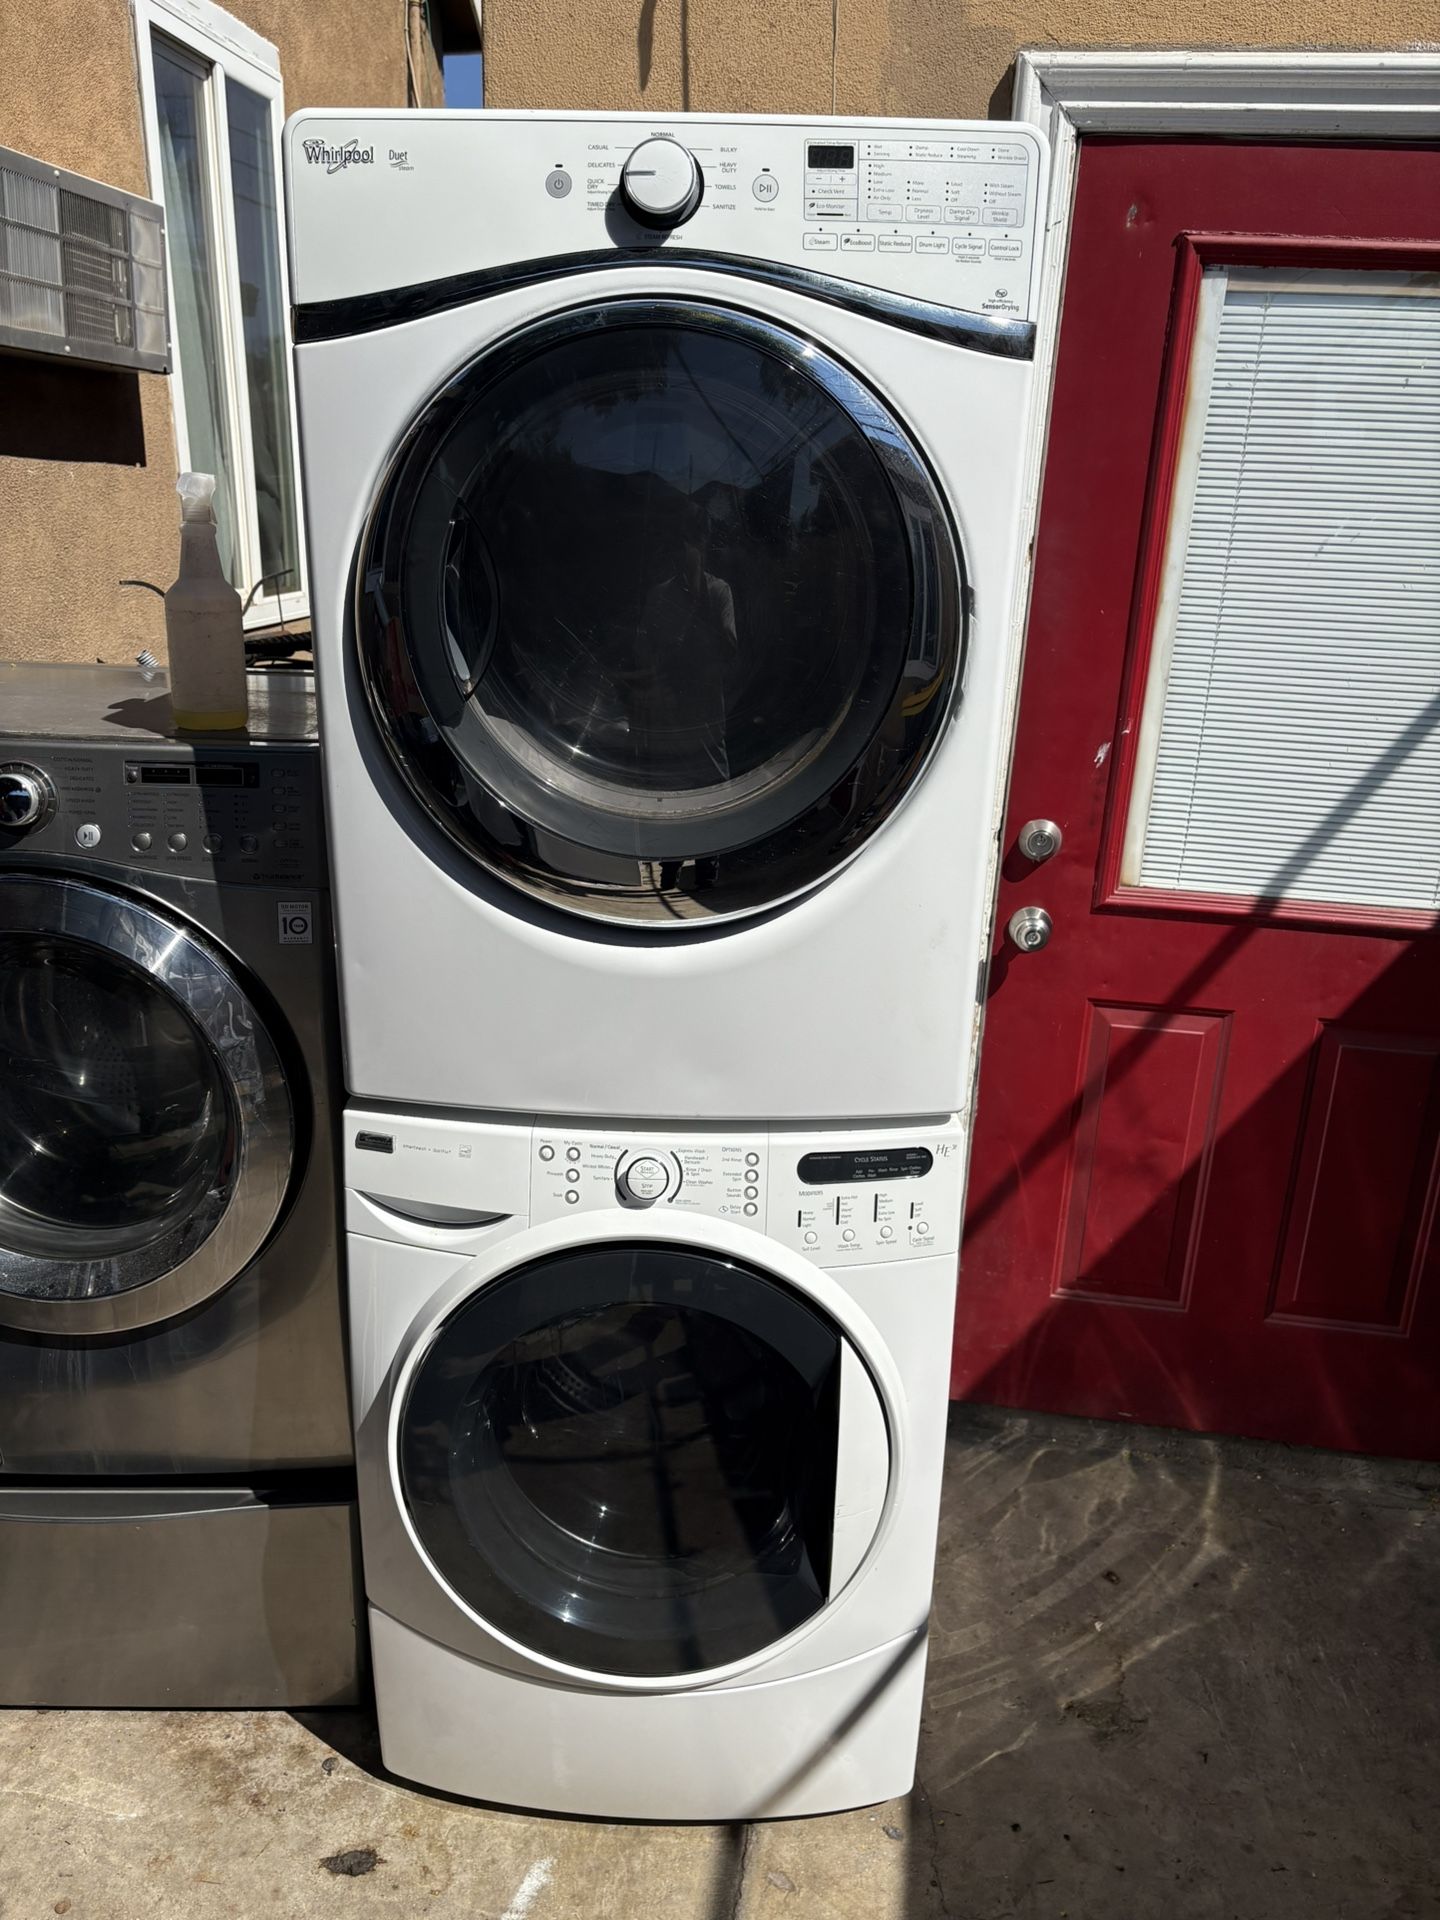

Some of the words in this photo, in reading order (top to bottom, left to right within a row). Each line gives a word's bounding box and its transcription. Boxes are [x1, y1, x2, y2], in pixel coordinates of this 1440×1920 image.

[303, 146, 374, 168] Whirlpool
[389, 150, 408, 161] Duet
[982, 303, 1020, 312] SensorDrying
[283, 917, 308, 934] 10
